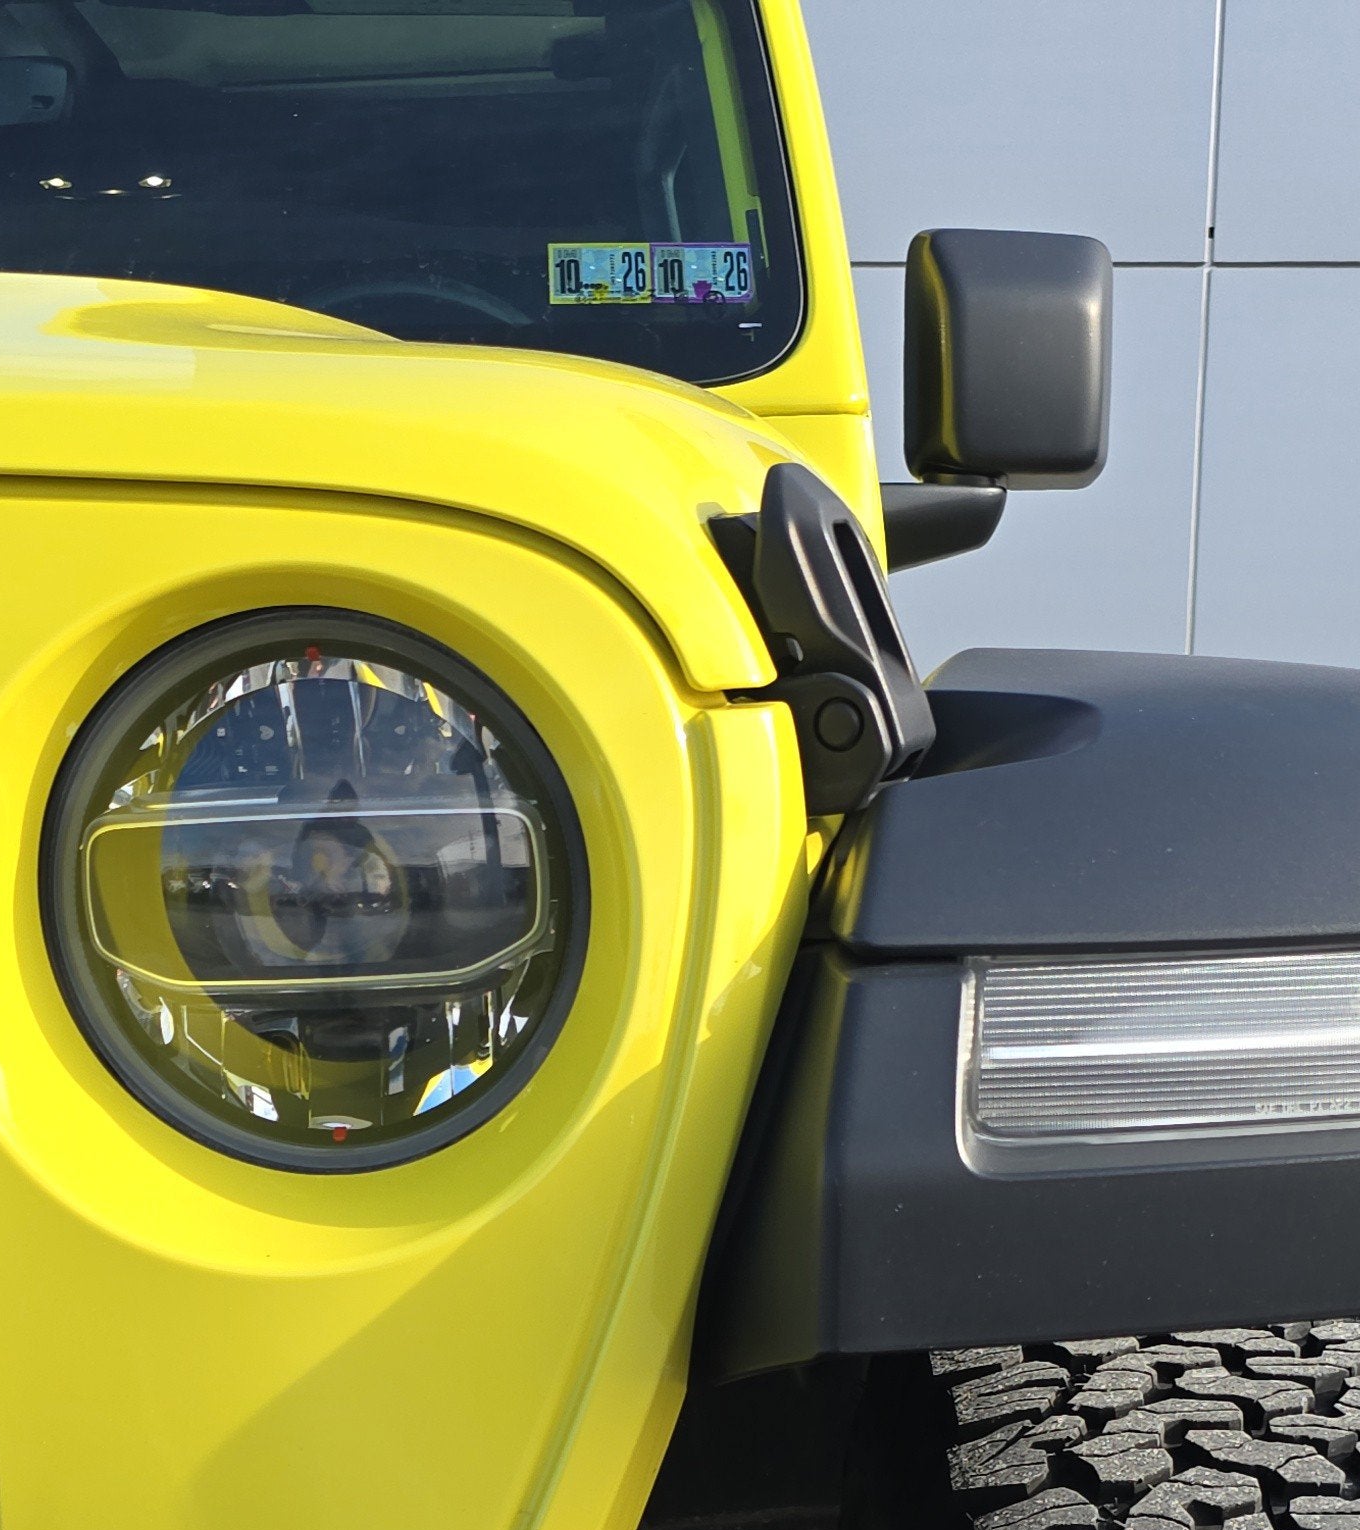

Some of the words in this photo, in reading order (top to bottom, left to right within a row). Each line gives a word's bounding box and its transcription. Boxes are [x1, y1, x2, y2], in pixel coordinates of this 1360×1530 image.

[555, 258, 581, 294] 10
[621, 251, 646, 292] 26
[658, 258, 684, 294] 10
[723, 251, 748, 291] 26
